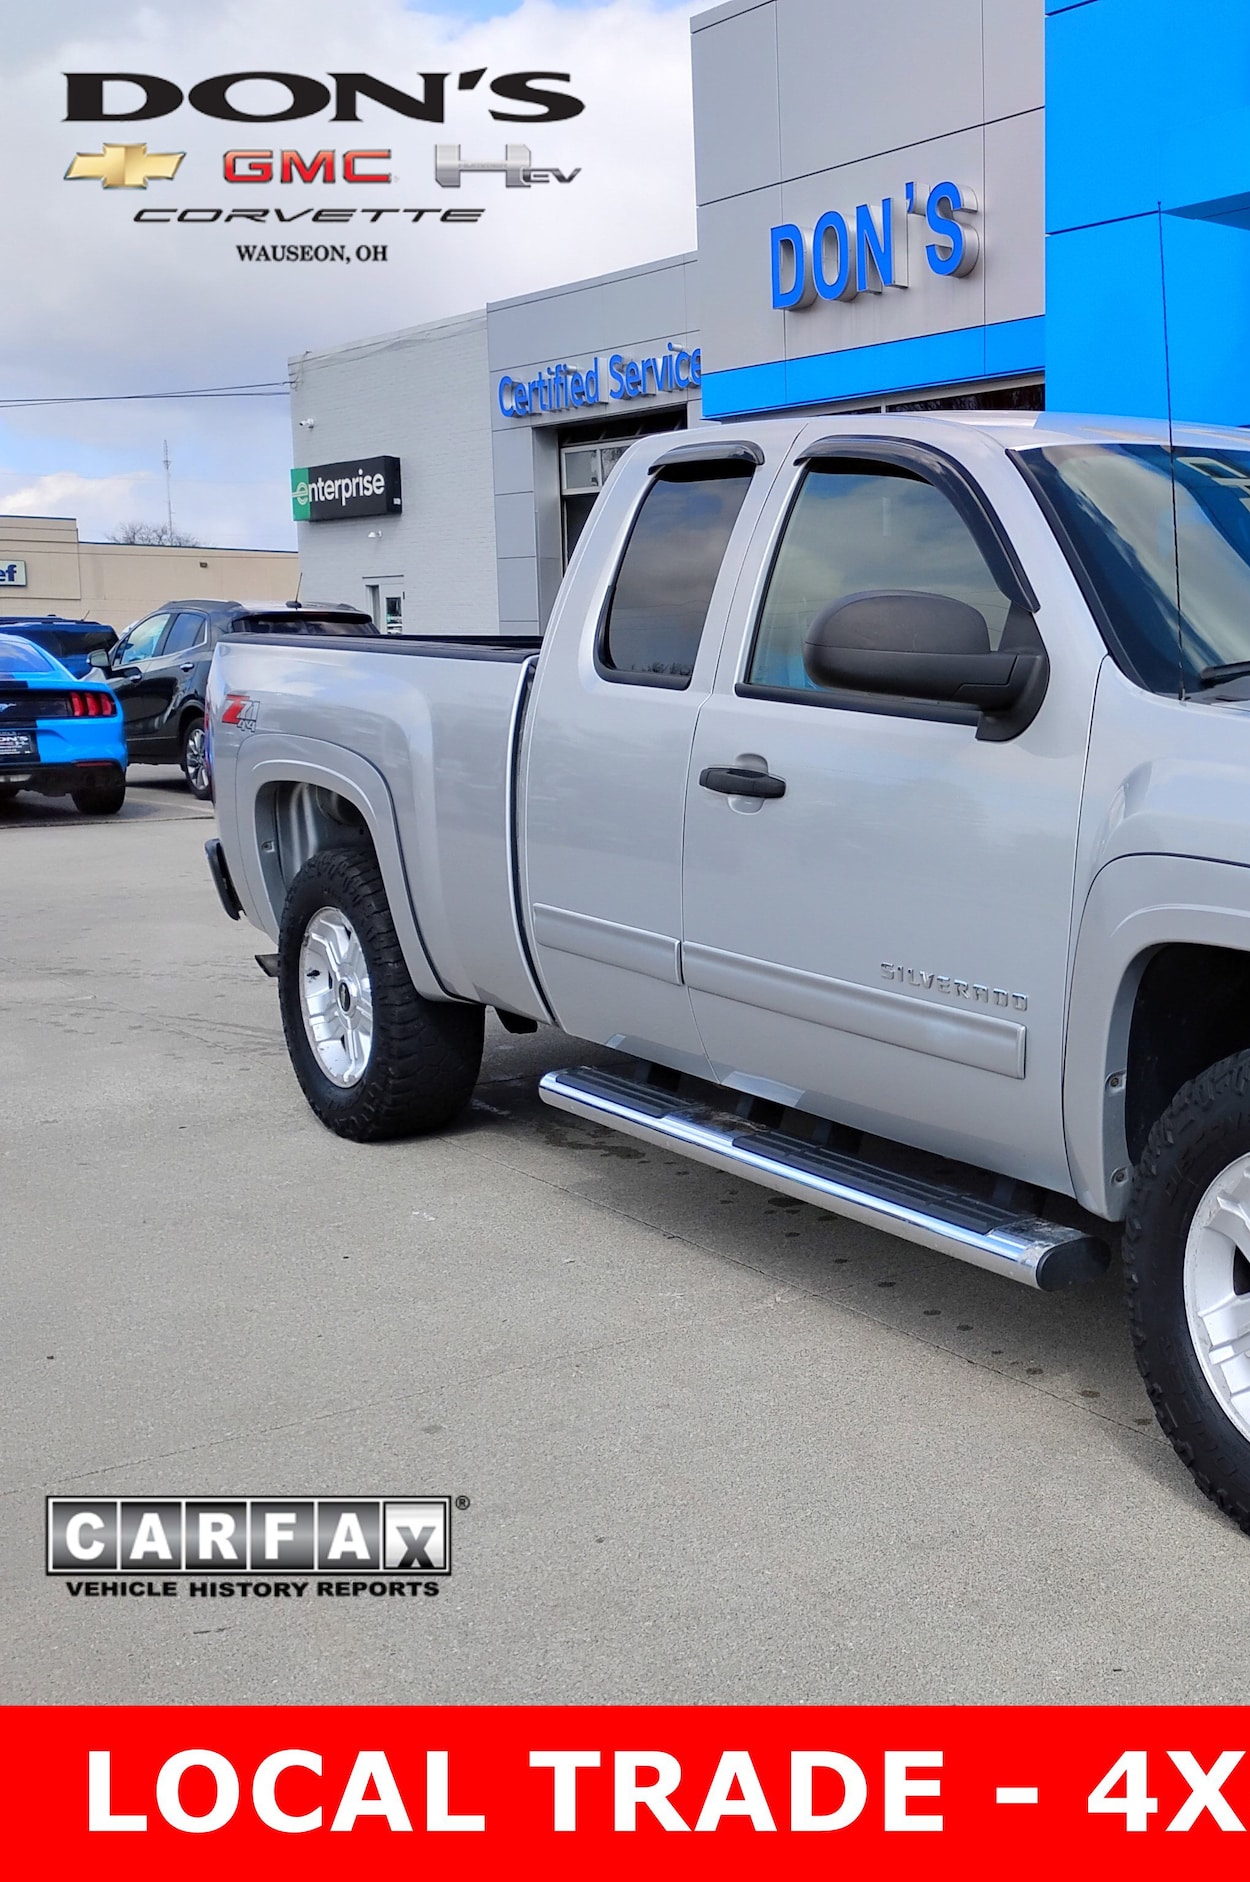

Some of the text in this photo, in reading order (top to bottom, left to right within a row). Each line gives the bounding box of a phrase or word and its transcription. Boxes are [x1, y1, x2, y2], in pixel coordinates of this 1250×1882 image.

[770, 180, 970, 311] DON'S
[498, 342, 701, 419] Certified Service
[293, 468, 385, 507] enterprise
[880, 961, 1029, 1012] SILVERADO
